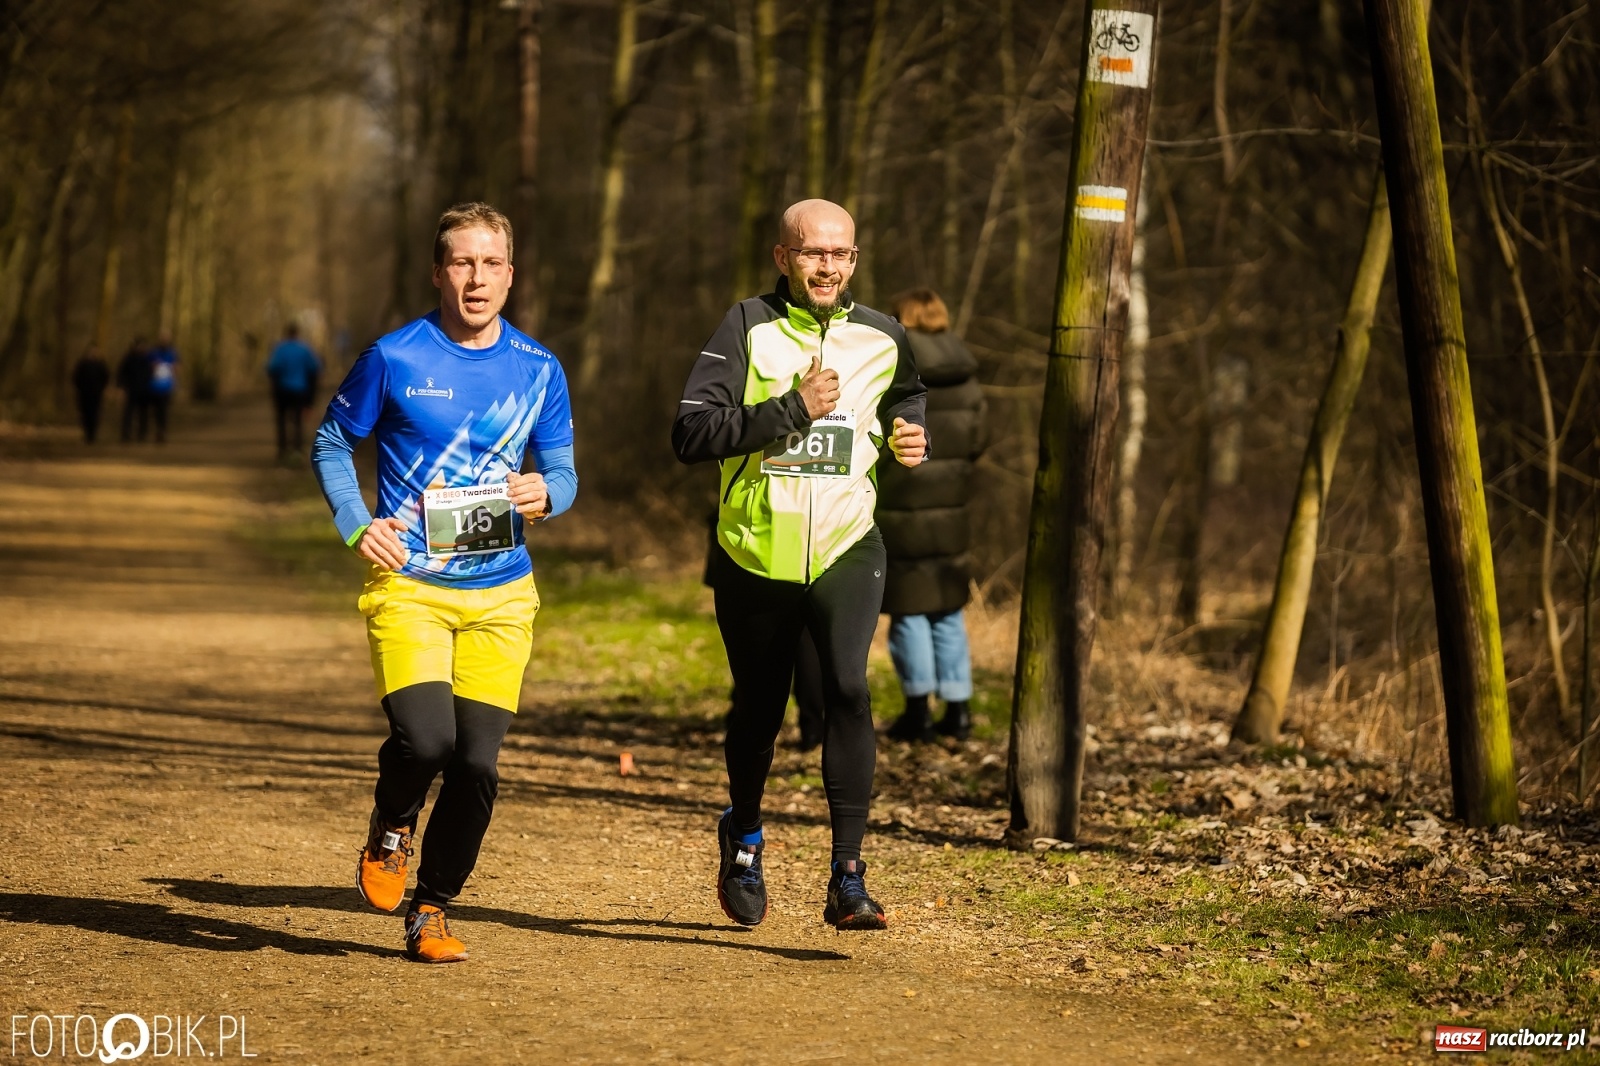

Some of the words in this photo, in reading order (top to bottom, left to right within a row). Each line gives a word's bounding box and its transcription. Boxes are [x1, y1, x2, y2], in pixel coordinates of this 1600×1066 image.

[510, 340, 552, 359] 13.10.2019
[818, 413, 847, 421] dziela
[786, 431, 834, 458] 061
[443, 490, 461, 499] BIEG
[462, 487, 504, 497] Twardziela
[452, 508, 493, 535] 115
